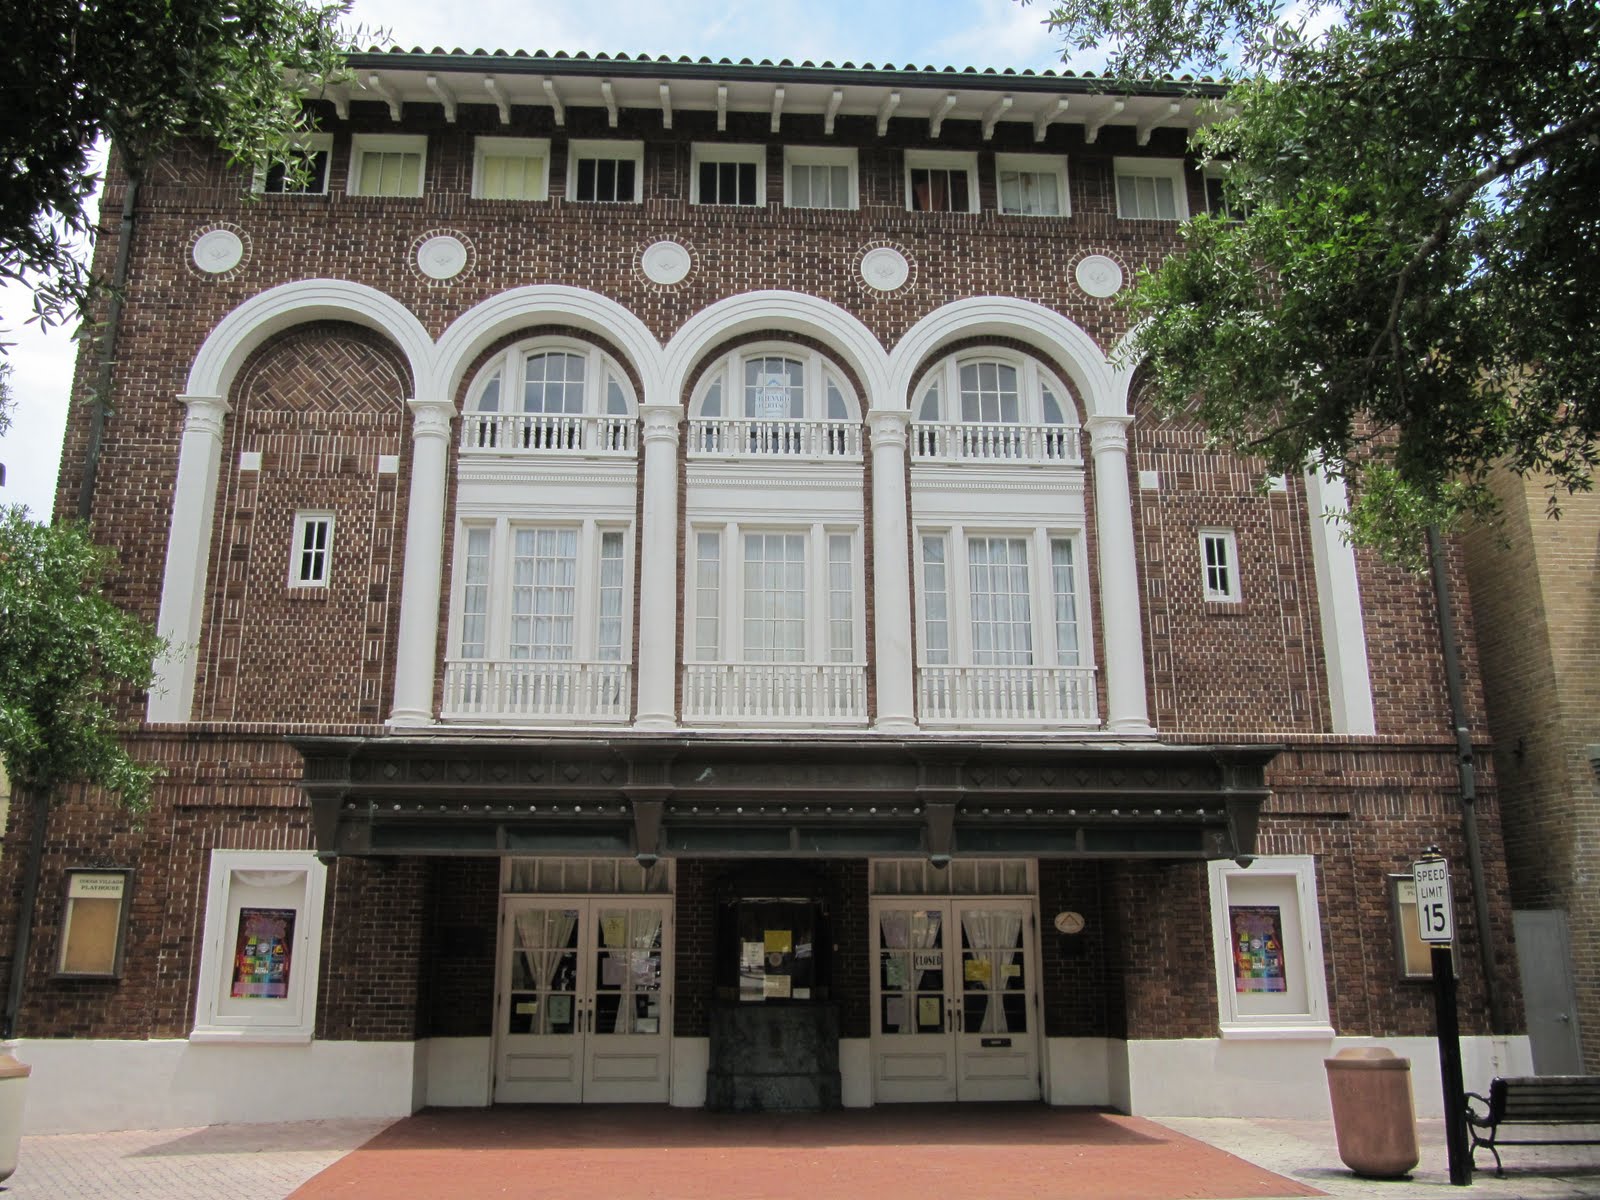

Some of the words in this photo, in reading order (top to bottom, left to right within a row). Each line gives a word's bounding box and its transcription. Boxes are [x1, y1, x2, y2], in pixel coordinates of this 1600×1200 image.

[1416, 869, 1446, 882] SPEED
[1420, 886, 1443, 899] LIMIT
[1423, 903, 1446, 932] 15
[915, 955, 942, 966] CLOSED
